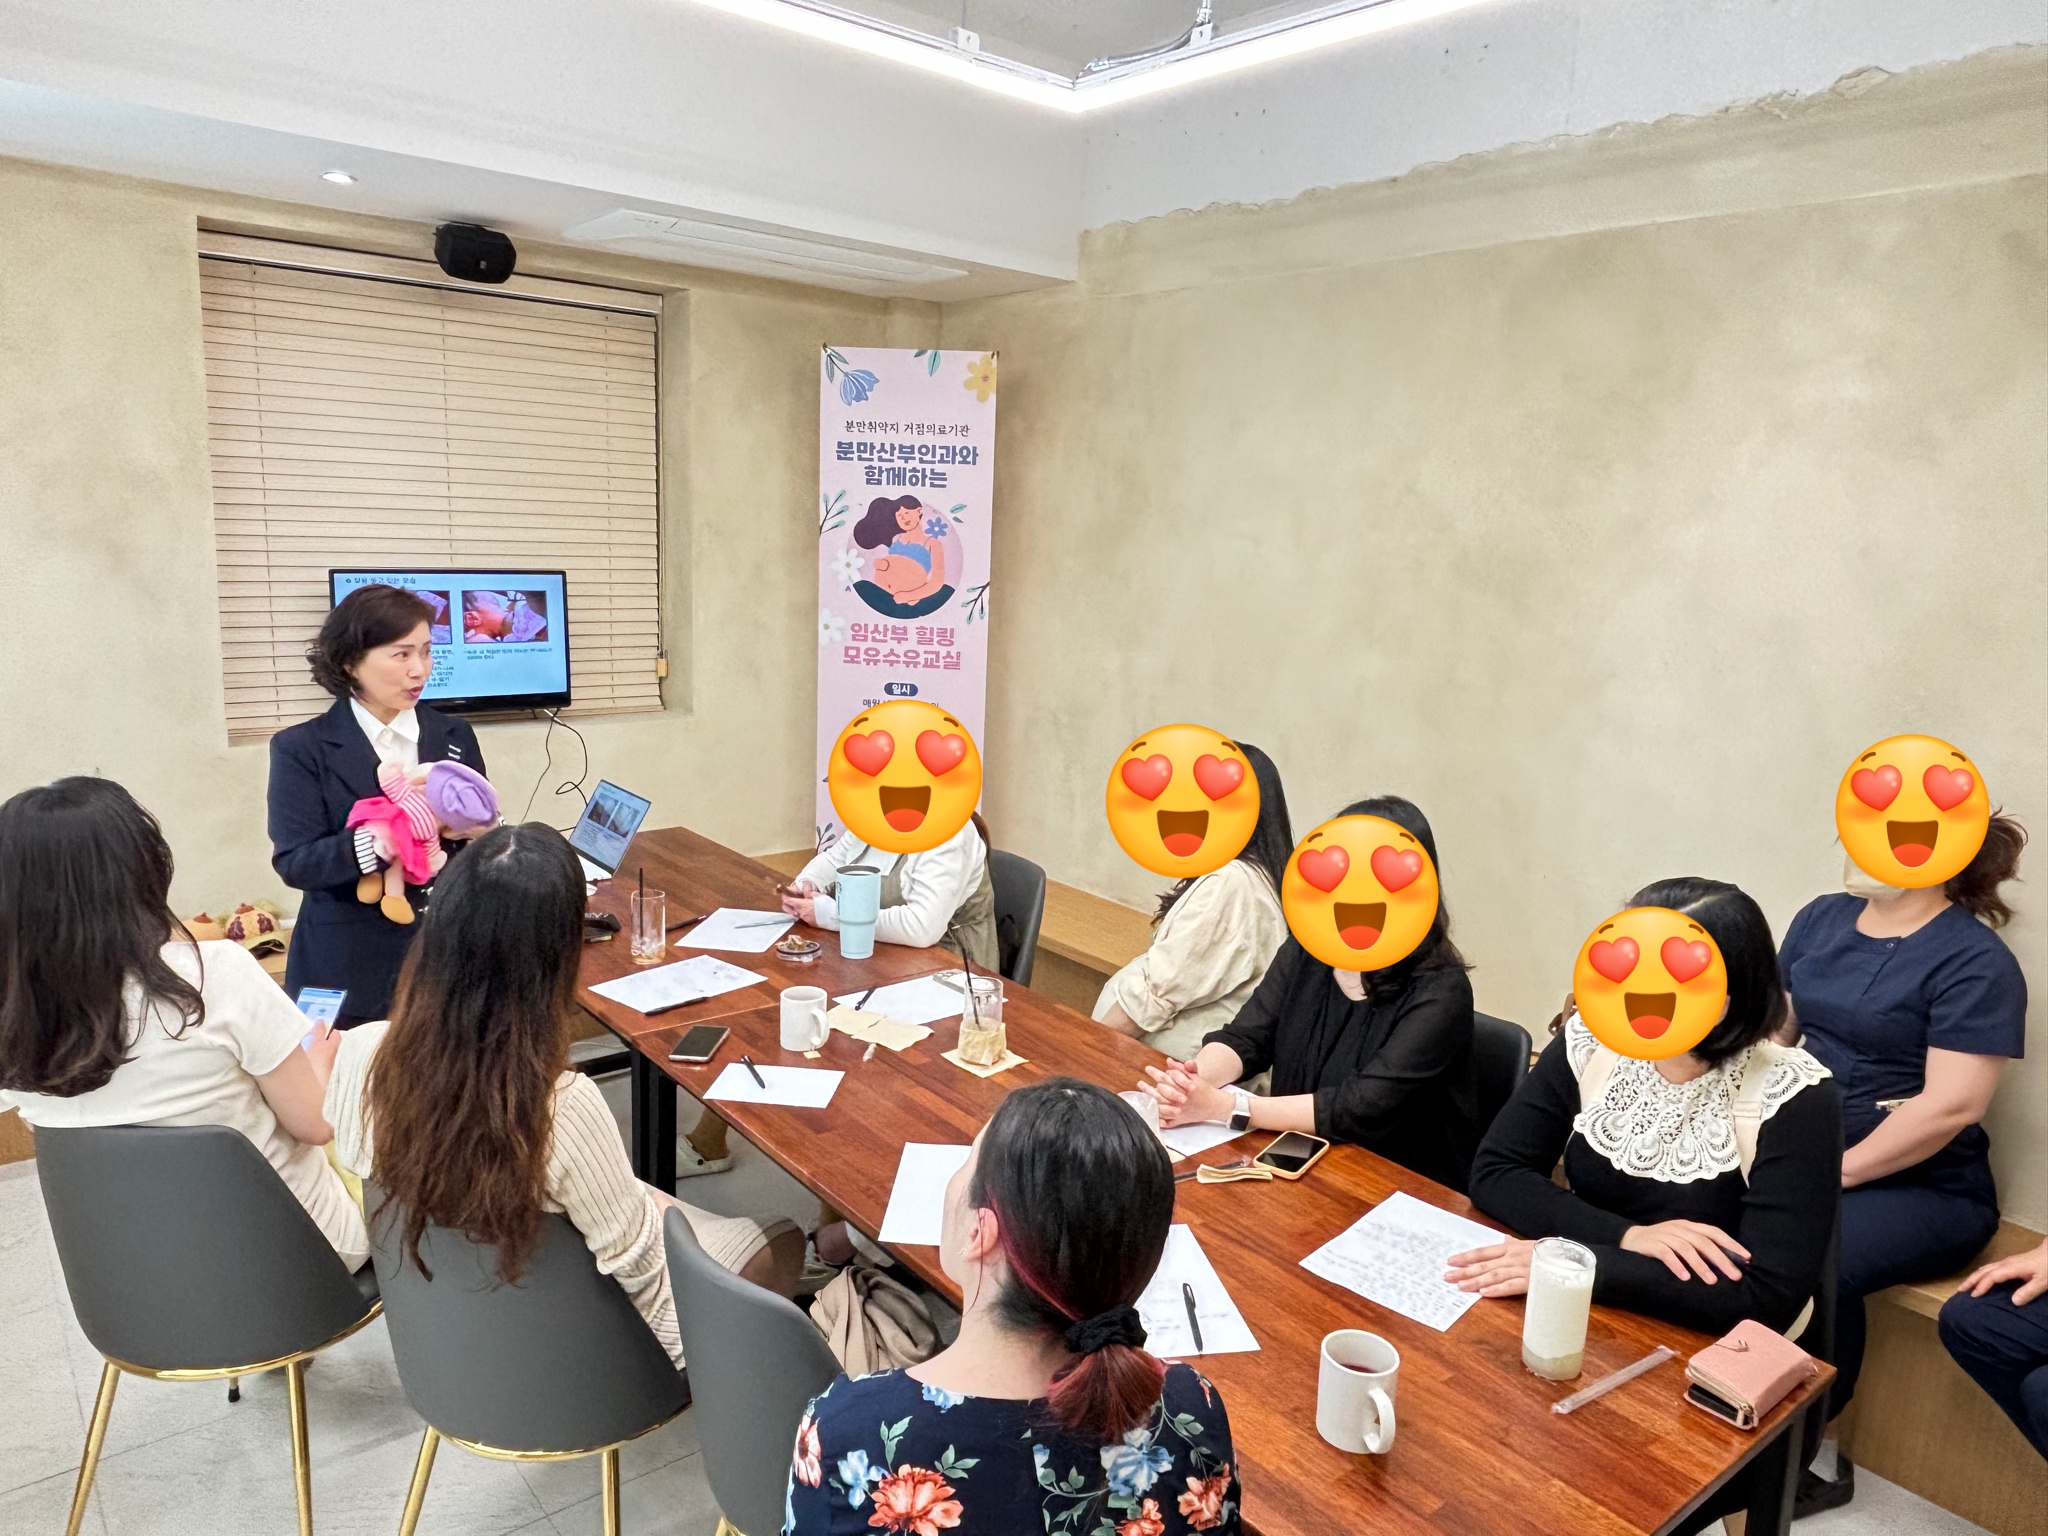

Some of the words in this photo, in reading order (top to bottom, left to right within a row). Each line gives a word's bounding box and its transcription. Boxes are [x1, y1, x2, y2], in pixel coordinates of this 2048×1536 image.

[845, 420, 899, 434] 분만취약지
[903, 423, 970, 437] 거점의료기관
[836, 441, 979, 466] 분만산부인과와
[864, 465, 948, 488] 함께하는
[850, 622, 909, 644] 임산부
[915, 625, 955, 647] 힐링
[843, 646, 961, 671] 모유수유교실
[892, 684, 911, 695] 일시
